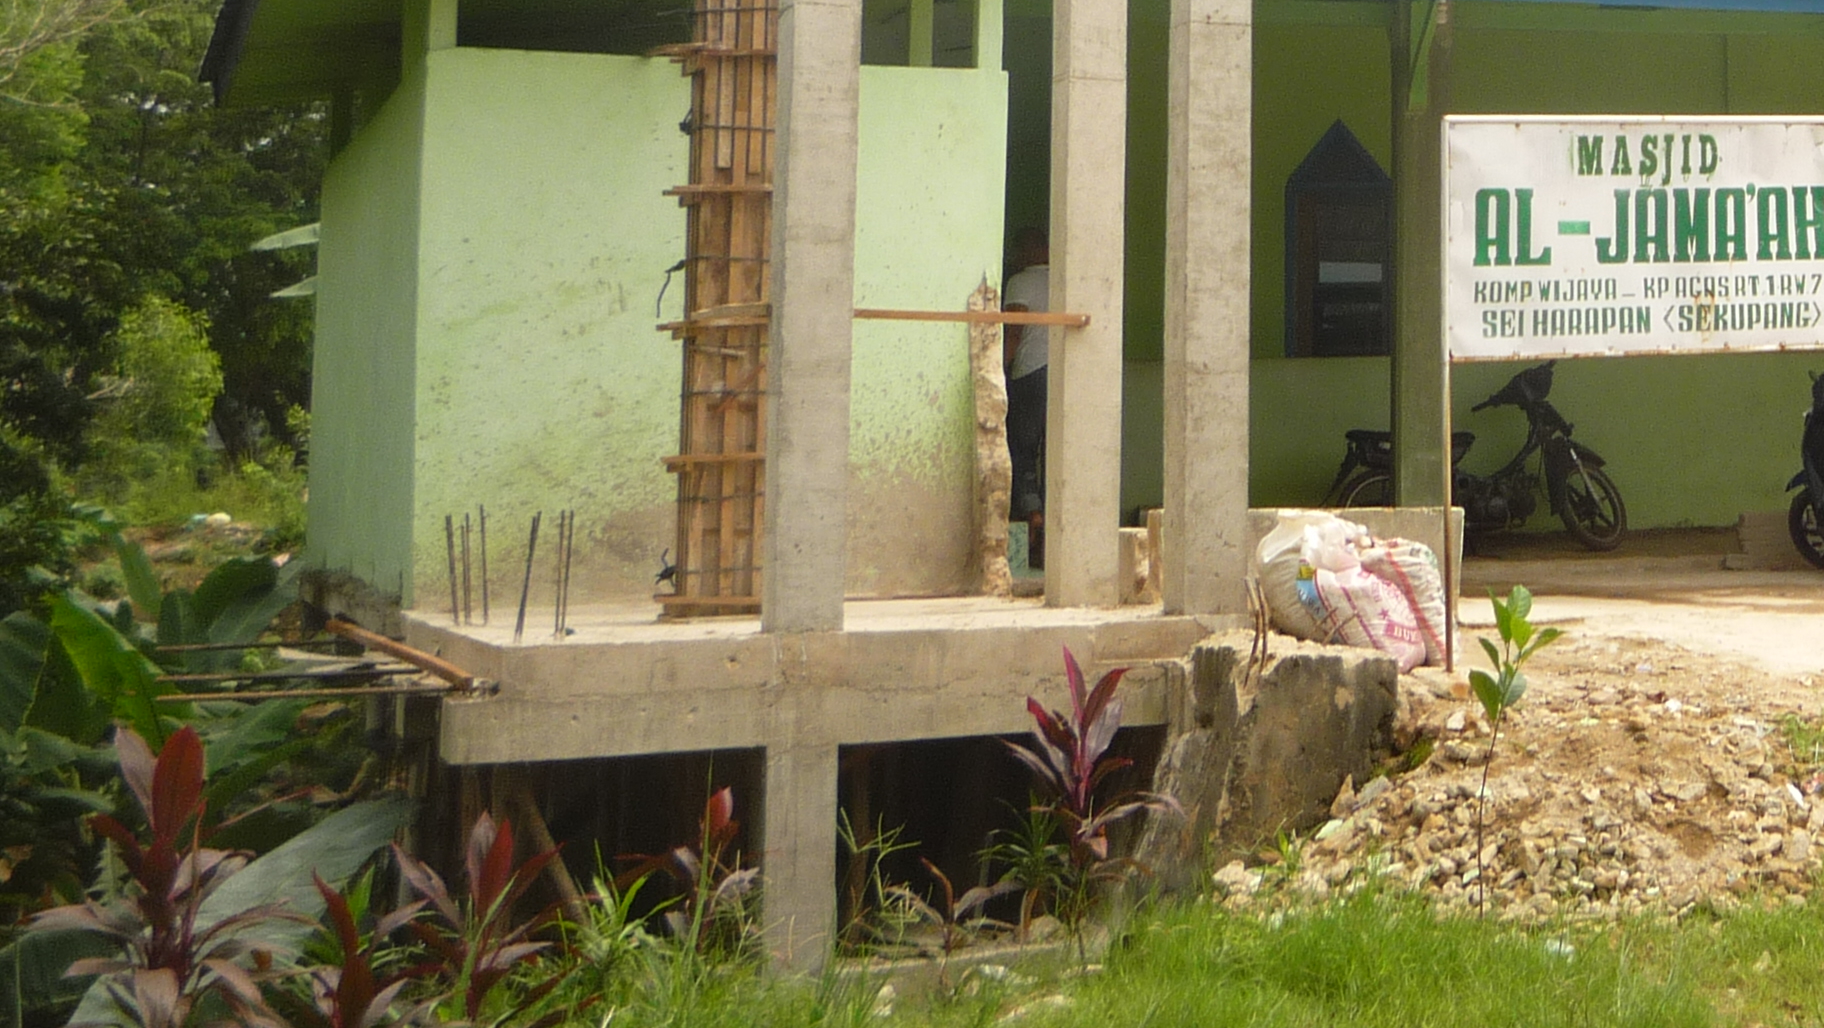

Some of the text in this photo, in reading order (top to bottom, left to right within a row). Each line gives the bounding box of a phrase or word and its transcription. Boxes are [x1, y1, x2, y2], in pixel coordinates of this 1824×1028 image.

[1577, 134, 1719, 186] MASJID
[1538, 278, 1617, 302] WIJAYA
[1482, 309, 1525, 339] SEI
[1532, 305, 1652, 338] HARAPAN
